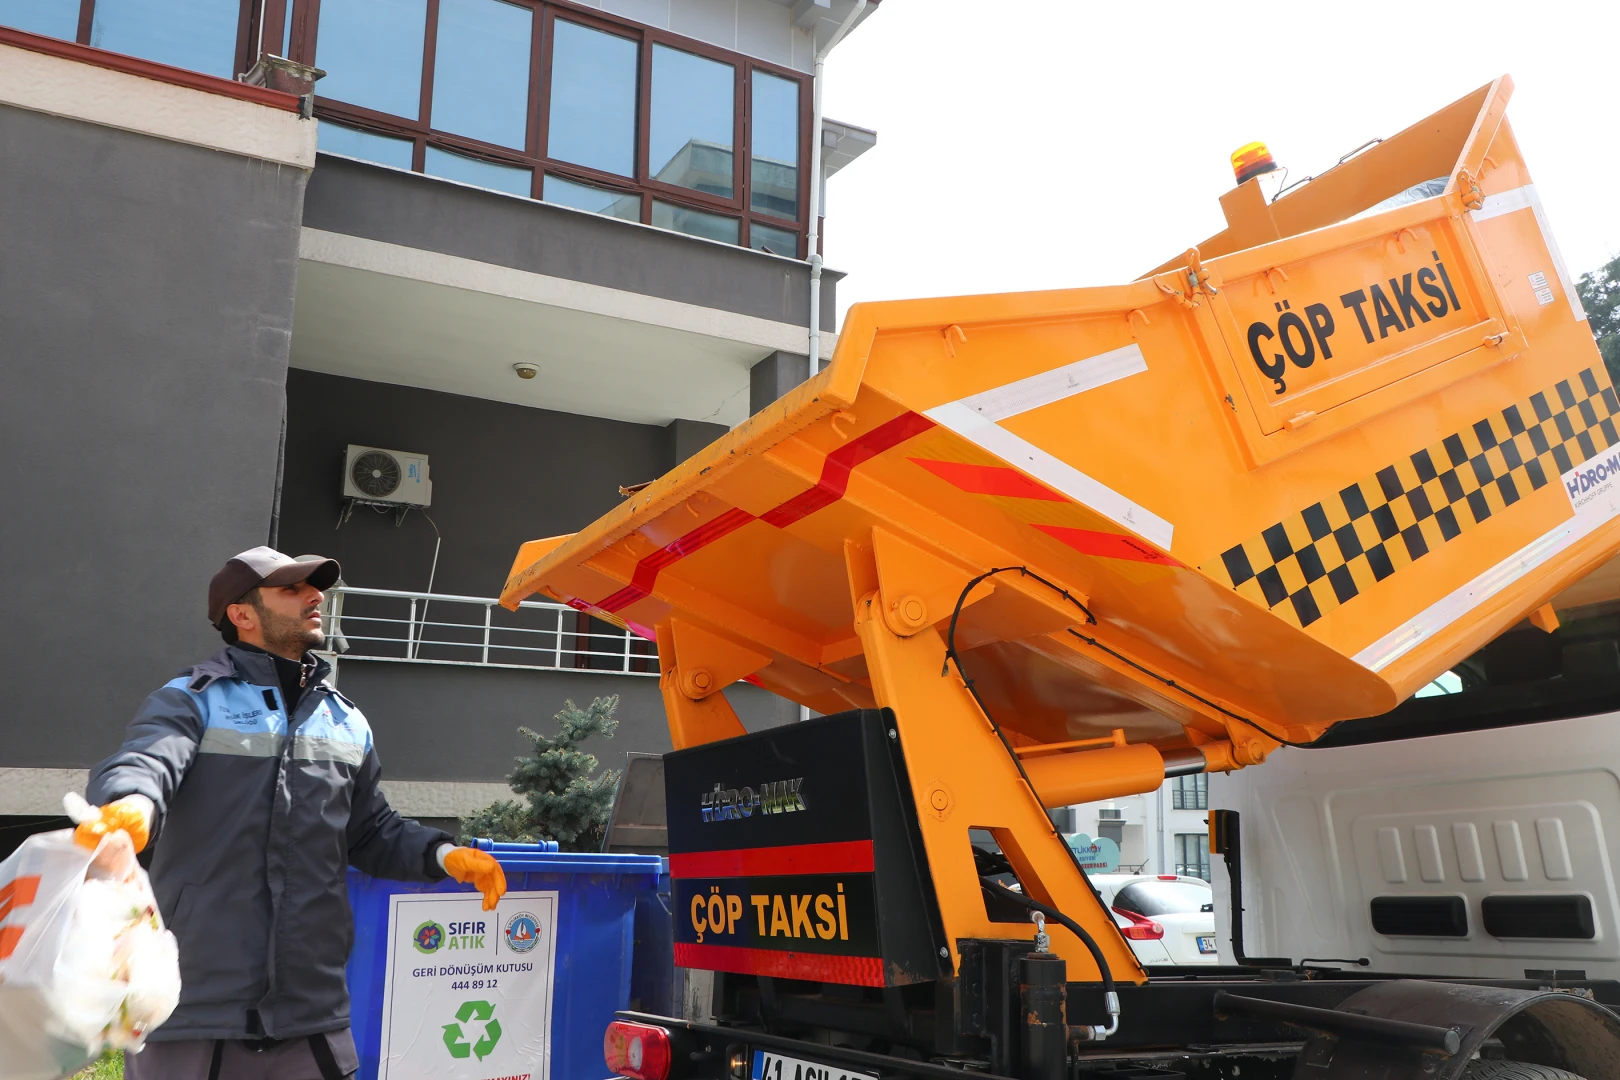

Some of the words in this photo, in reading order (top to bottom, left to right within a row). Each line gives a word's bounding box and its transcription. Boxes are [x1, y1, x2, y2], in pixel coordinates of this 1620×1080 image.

[1247, 300, 1335, 394] ÇÖP
[1340, 250, 1462, 344] TAKSİ
[701, 777, 807, 822] HİDRO-MAK
[691, 886, 743, 943] ÇÖP
[751, 883, 849, 940] TAKSİ
[448, 922, 486, 935] SIFIR
[448, 935, 485, 950] ATIK
[412, 965, 437, 977] GERİ
[439, 964, 494, 977] DÖNÜŞÜM
[496, 963, 533, 973] KUTUSU
[451, 981, 469, 990] 444
[472, 980, 484, 989] 89
[486, 979, 498, 988] 12
